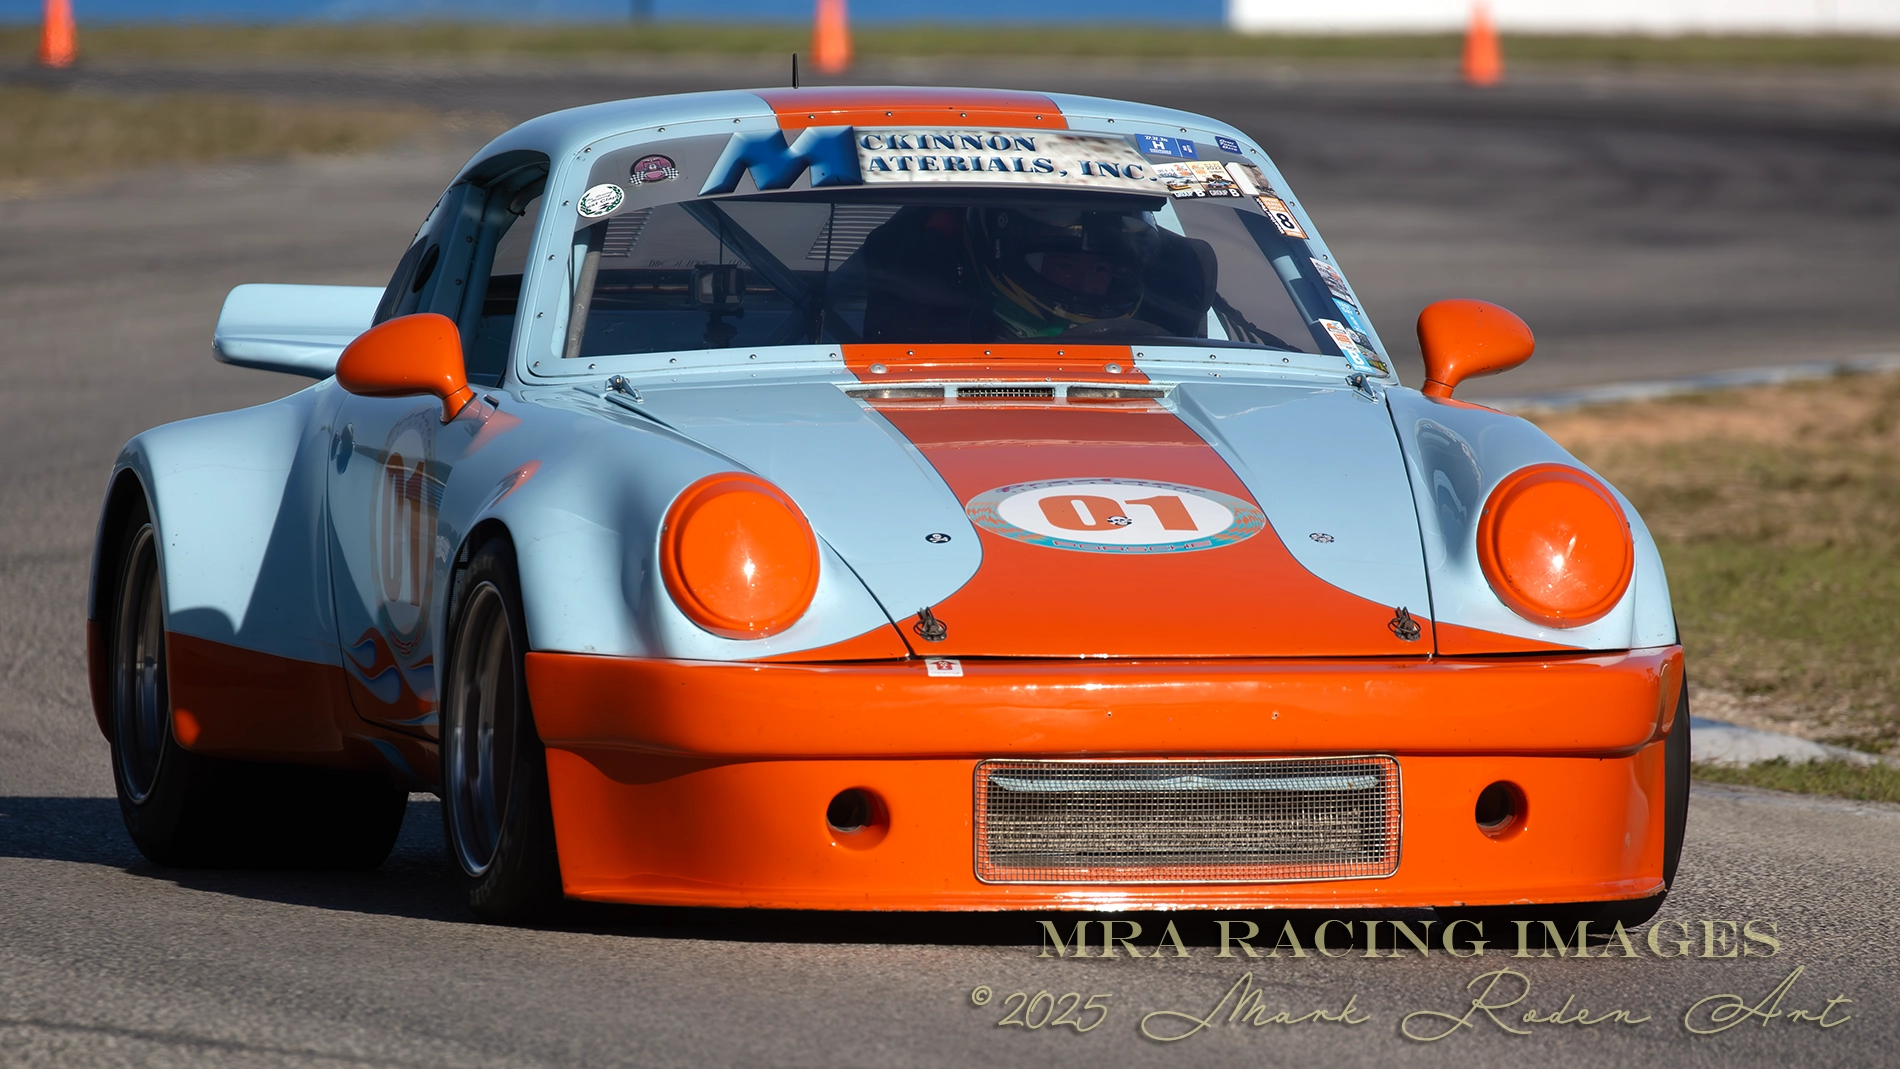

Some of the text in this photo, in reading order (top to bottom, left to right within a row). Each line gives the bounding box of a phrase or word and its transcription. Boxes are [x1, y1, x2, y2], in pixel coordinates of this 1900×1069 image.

[1077, 160, 1158, 182] INC.
[1229, 189, 1240, 197] B
[1276, 212, 1295, 230] 8
[1037, 495, 1200, 531] 01
[381, 452, 425, 608] 01
